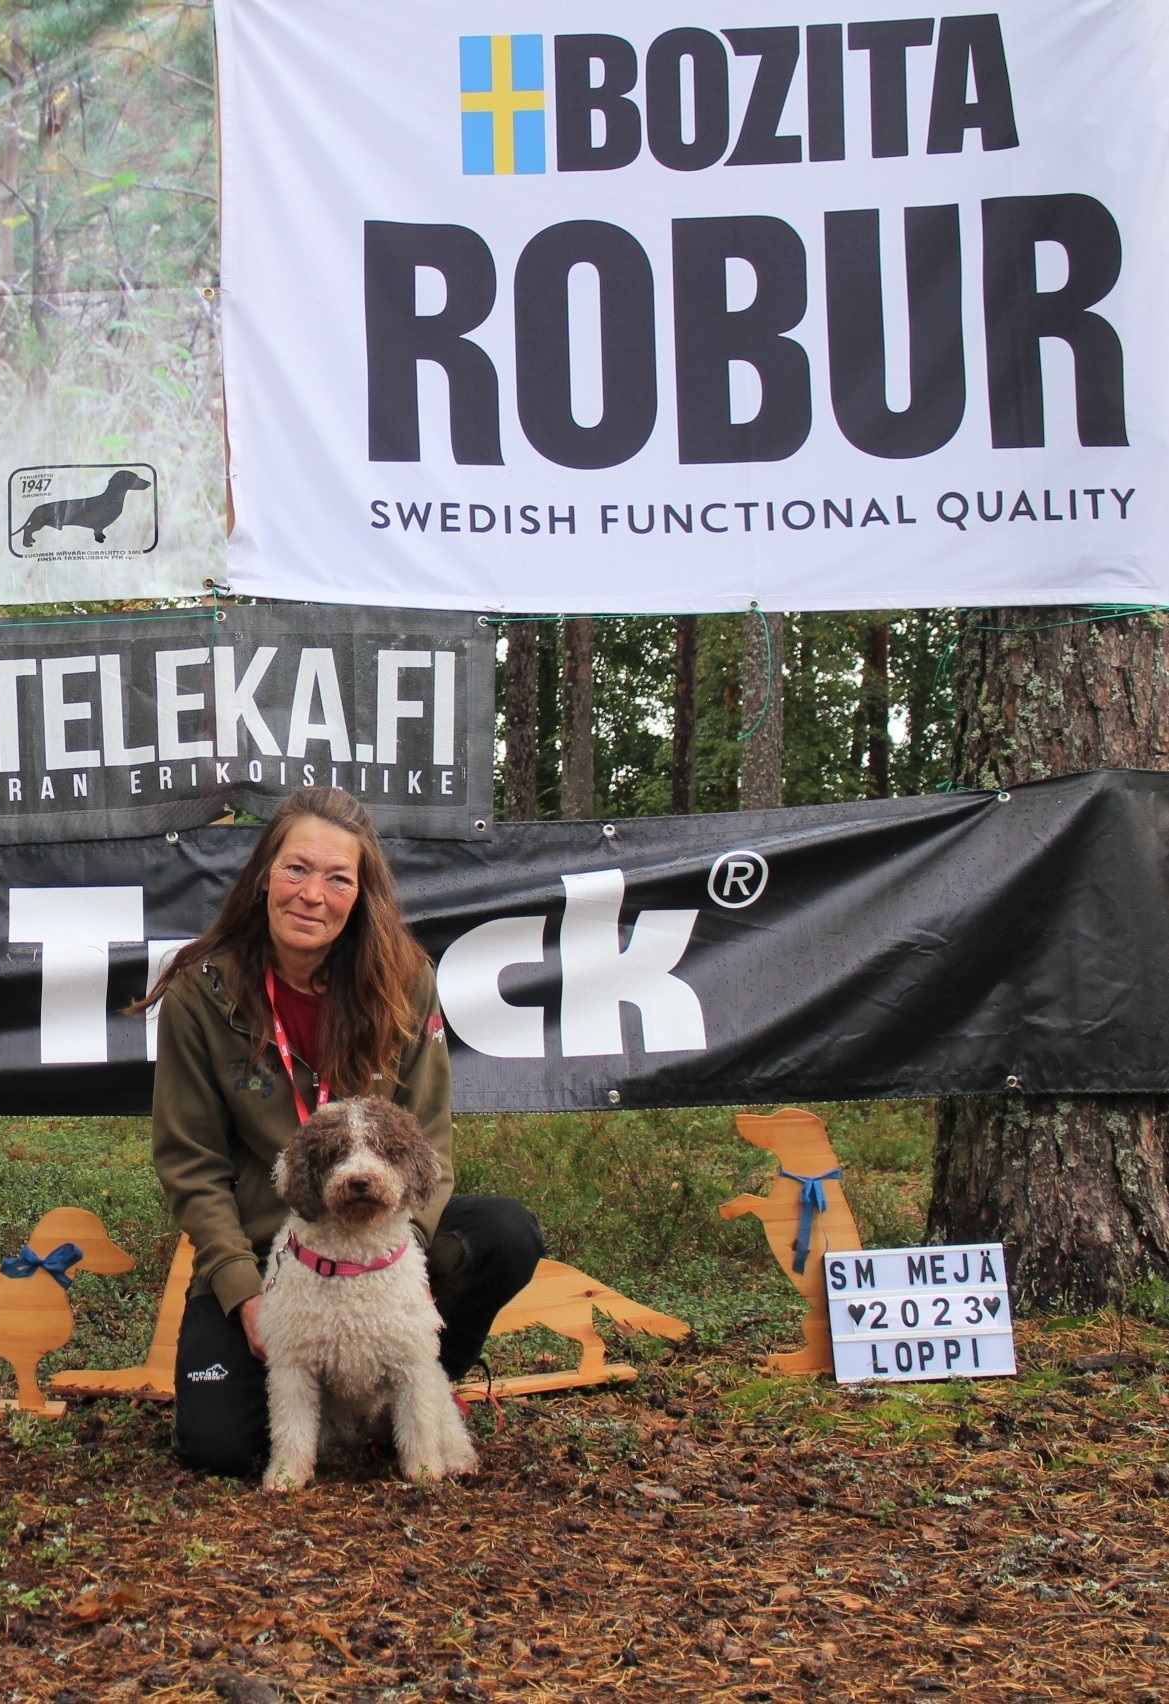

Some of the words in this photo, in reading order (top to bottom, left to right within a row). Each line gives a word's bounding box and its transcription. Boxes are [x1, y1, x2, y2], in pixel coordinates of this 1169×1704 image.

[553, 13, 1020, 173] BOZITA
[363, 192, 1131, 470] ROBUR
[22, 478, 52, 493] 1947
[370, 499, 576, 534] SWEDISH
[600, 495, 917, 534] FUNCTIONAL
[936, 488, 1136, 531] QUALITY
[130, 759, 454, 796] ERIKOISLIIKE
[830, 1258, 875, 1290] SM
[907, 1251, 997, 1285] MEJÄ
[868, 1296, 983, 1329] 2023
[871, 1338, 979, 1373] LOPPI
